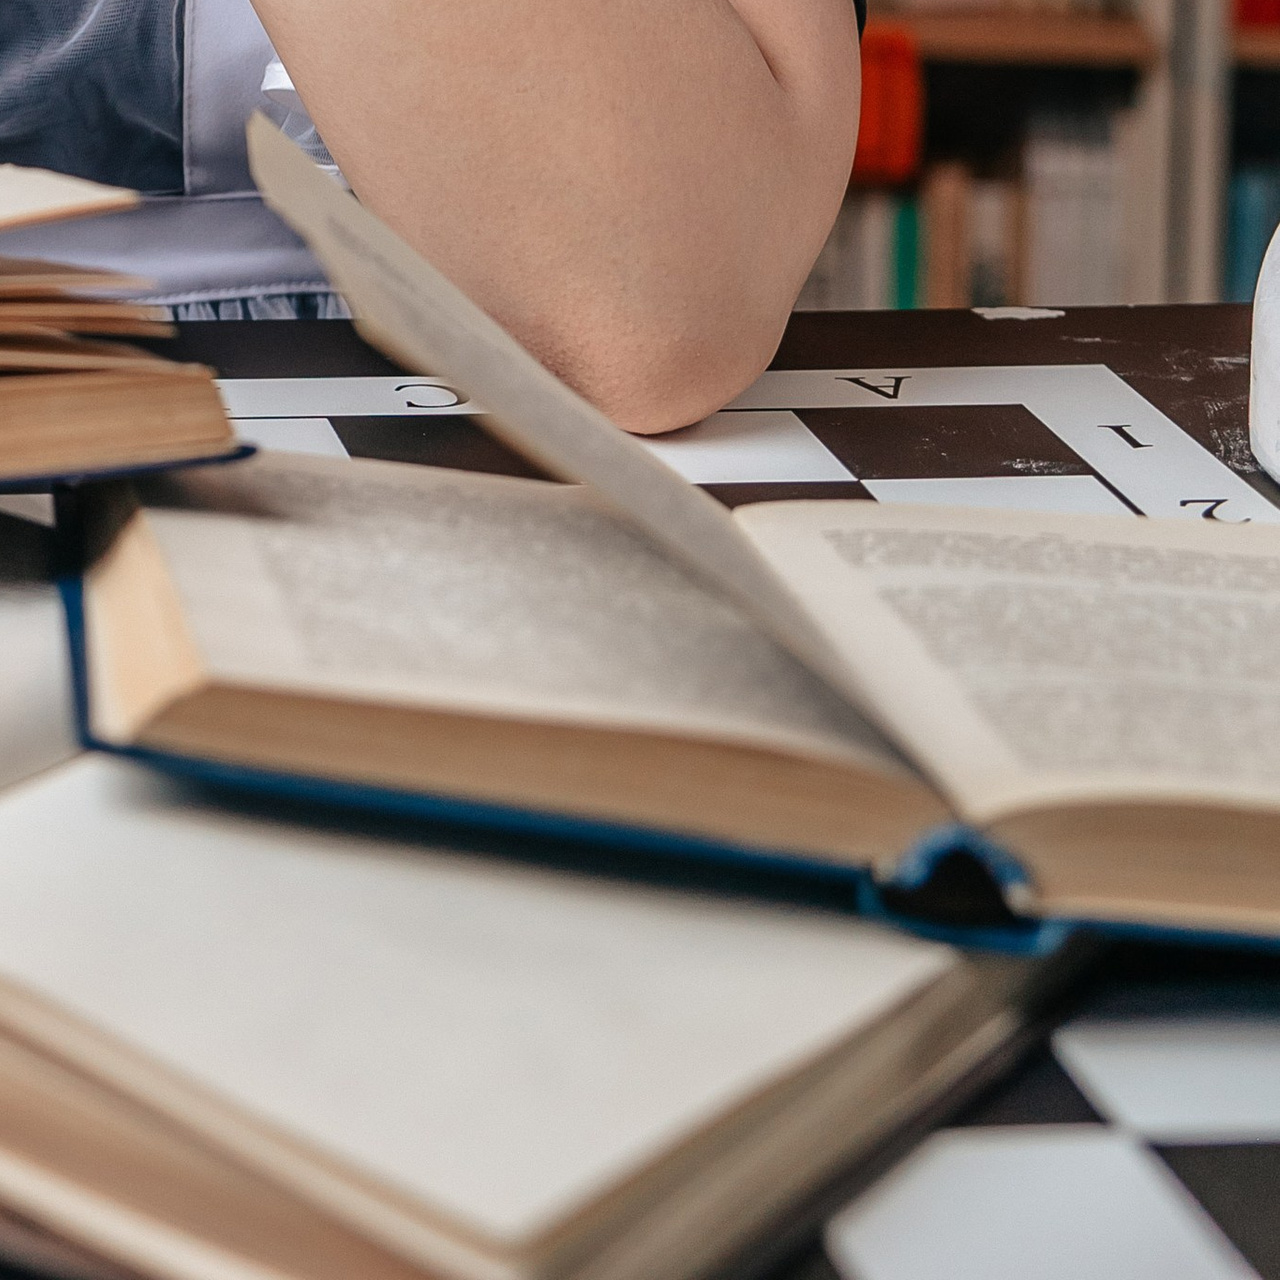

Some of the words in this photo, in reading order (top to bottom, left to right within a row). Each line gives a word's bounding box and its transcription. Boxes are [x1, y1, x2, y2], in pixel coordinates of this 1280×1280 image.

[394, 384, 469, 409] C
[834, 376, 912, 399] A
[1179, 498, 1251, 523] 2
